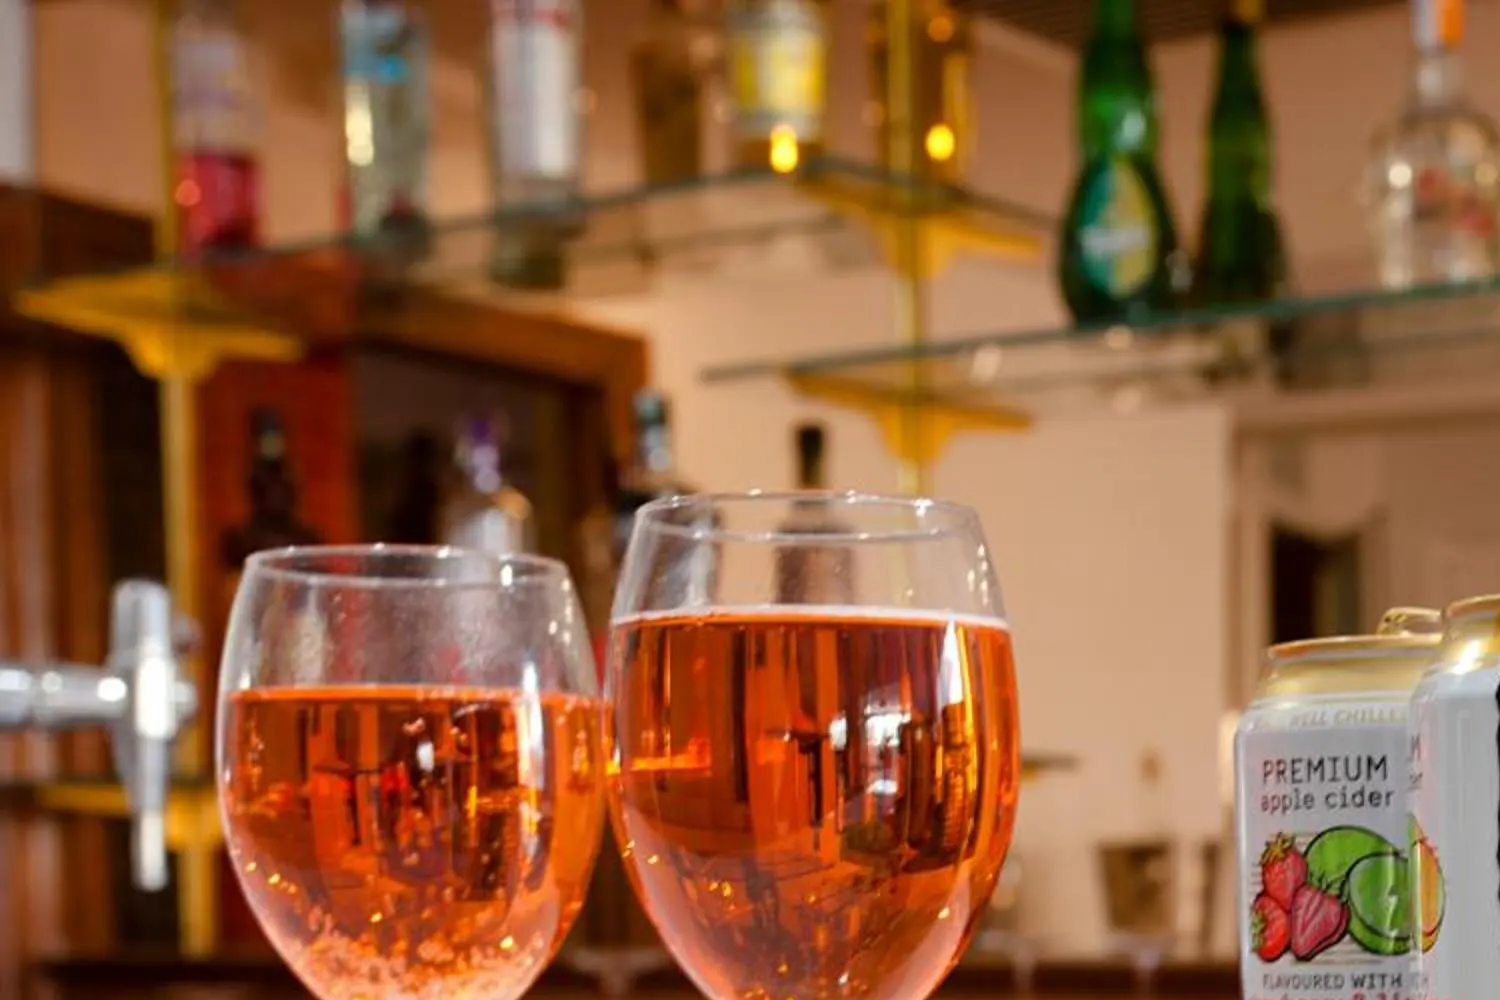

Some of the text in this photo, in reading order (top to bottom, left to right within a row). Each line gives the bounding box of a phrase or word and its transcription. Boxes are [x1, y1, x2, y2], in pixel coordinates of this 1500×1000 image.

[1262, 754, 1389, 785] PREMIUM
[1261, 784, 1396, 815] apple cider
[1262, 973, 1345, 990] FLAVOURED
[1352, 972, 1403, 990] WITH
